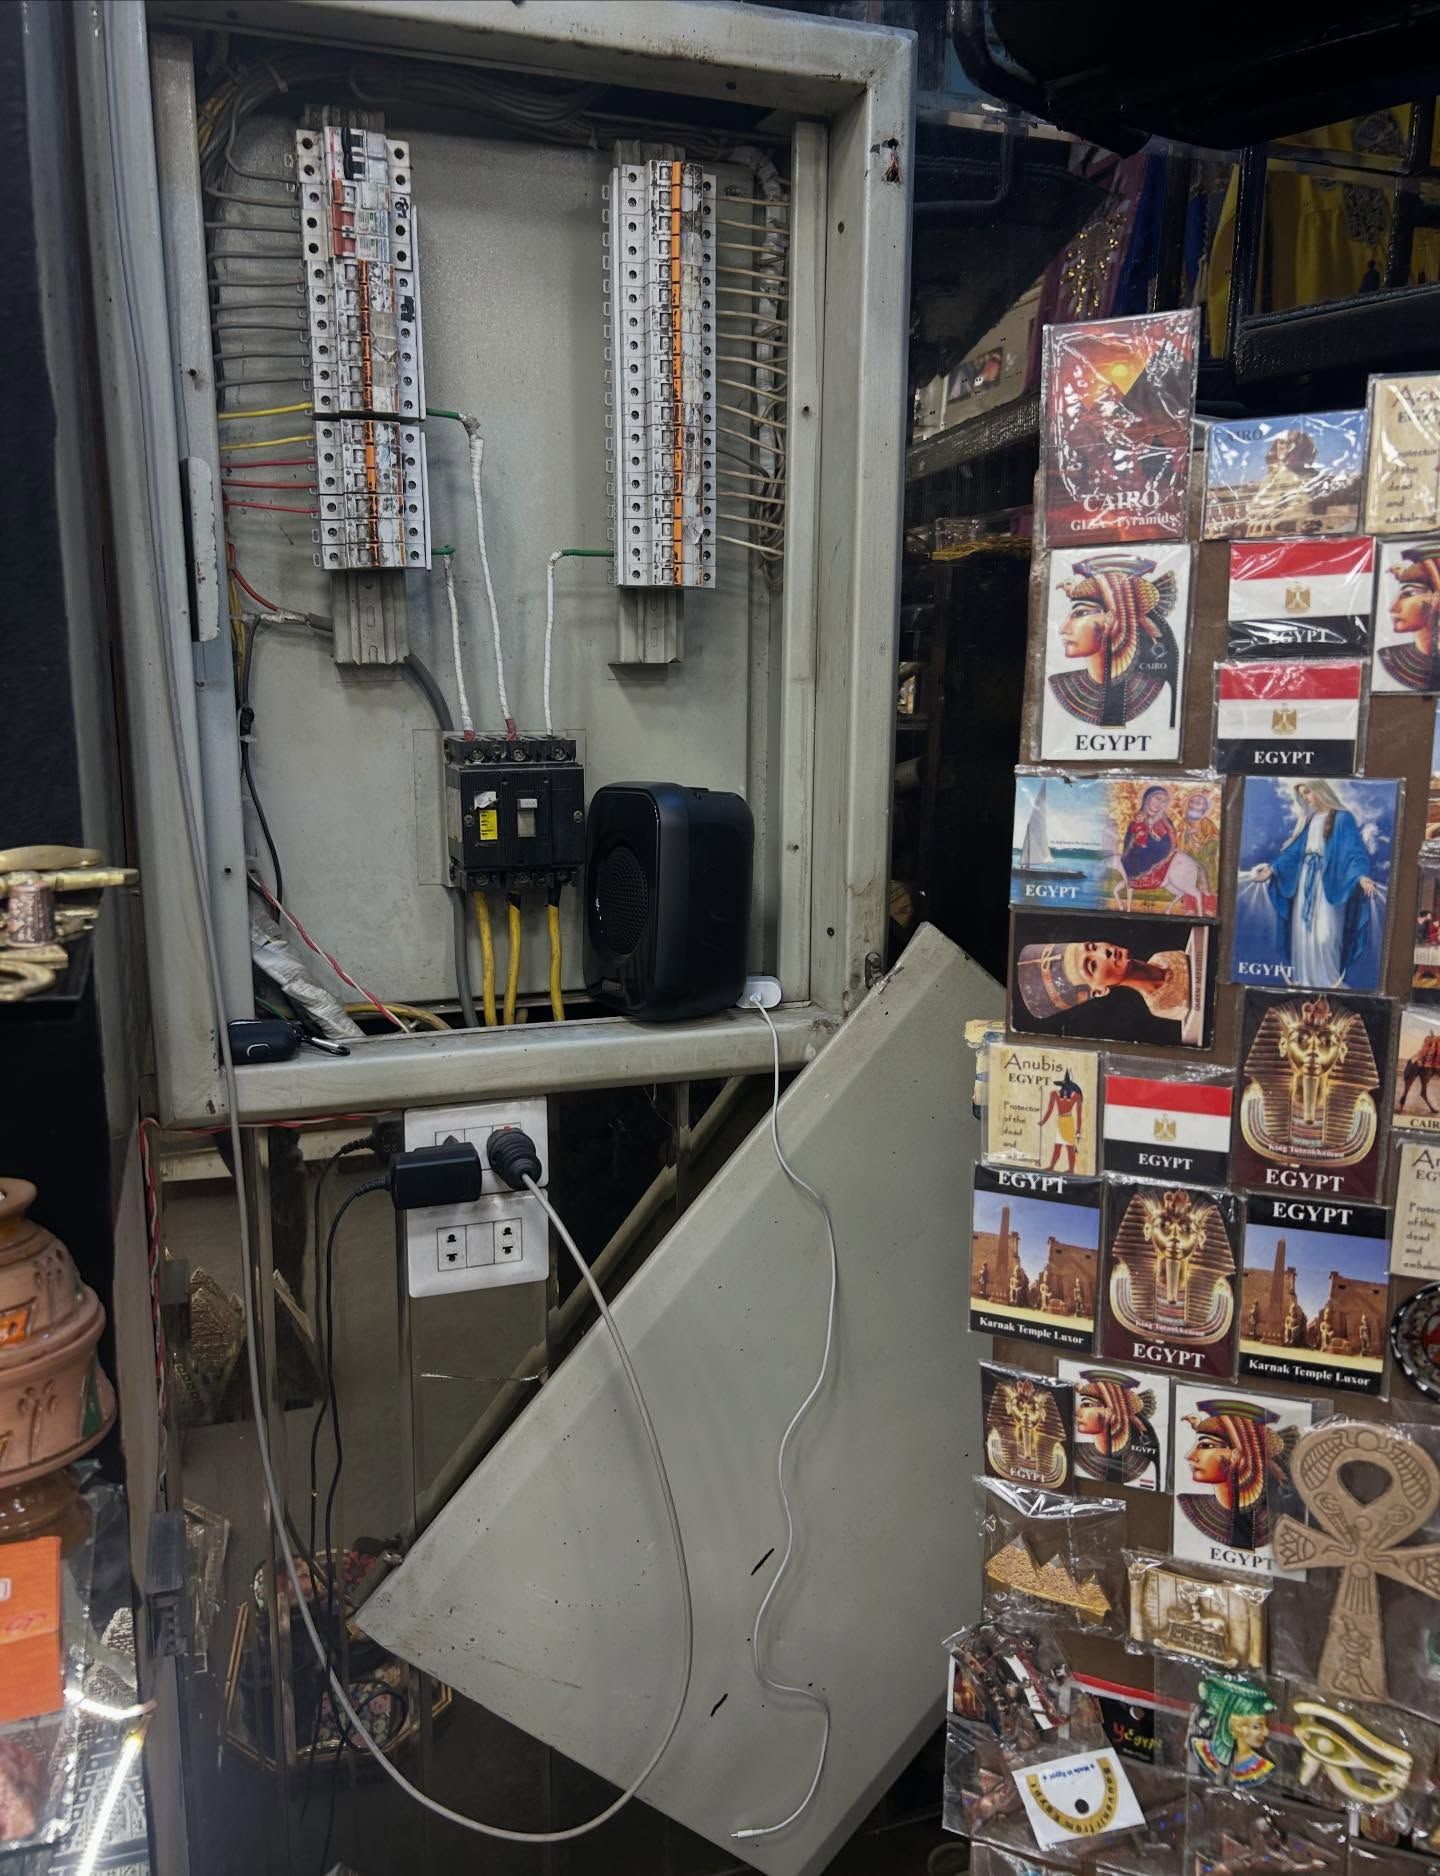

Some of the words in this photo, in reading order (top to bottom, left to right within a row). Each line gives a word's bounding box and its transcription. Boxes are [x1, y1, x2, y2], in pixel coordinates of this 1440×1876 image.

[1081, 489, 1160, 513] CAIRO
[1267, 629, 1329, 644] EGYPT
[1138, 662, 1168, 671] CAIRO
[1074, 734, 1153, 752] EGYPT
[1253, 750, 1315, 765] EGYPT
[1025, 884, 1080, 899] EGYPT
[1238, 961, 1296, 978] EGYPT
[1003, 1053, 1064, 1073] Anubis
[1007, 1072, 1052, 1087] EGYPT
[1138, 1153, 1194, 1170] EGYPT
[998, 1169, 1068, 1195] EGYPT
[1266, 1168, 1345, 1193] EGYPT
[1272, 1201, 1353, 1226] EGYPT
[979, 1316, 1016, 1332] Karnak
[1017, 1323, 1052, 1339] Temple
[1053, 1331, 1085, 1345] Luxor
[1132, 1342, 1206, 1368] EGYPT
[1248, 1359, 1290, 1374] Karnak
[1292, 1365, 1333, 1380] Temple
[1335, 1371, 1371, 1386] Luxor
[1131, 1444, 1157, 1455] EGYPT
[1009, 1467, 1046, 1483] EGYPT
[1209, 1547, 1274, 1571] EGYPT
